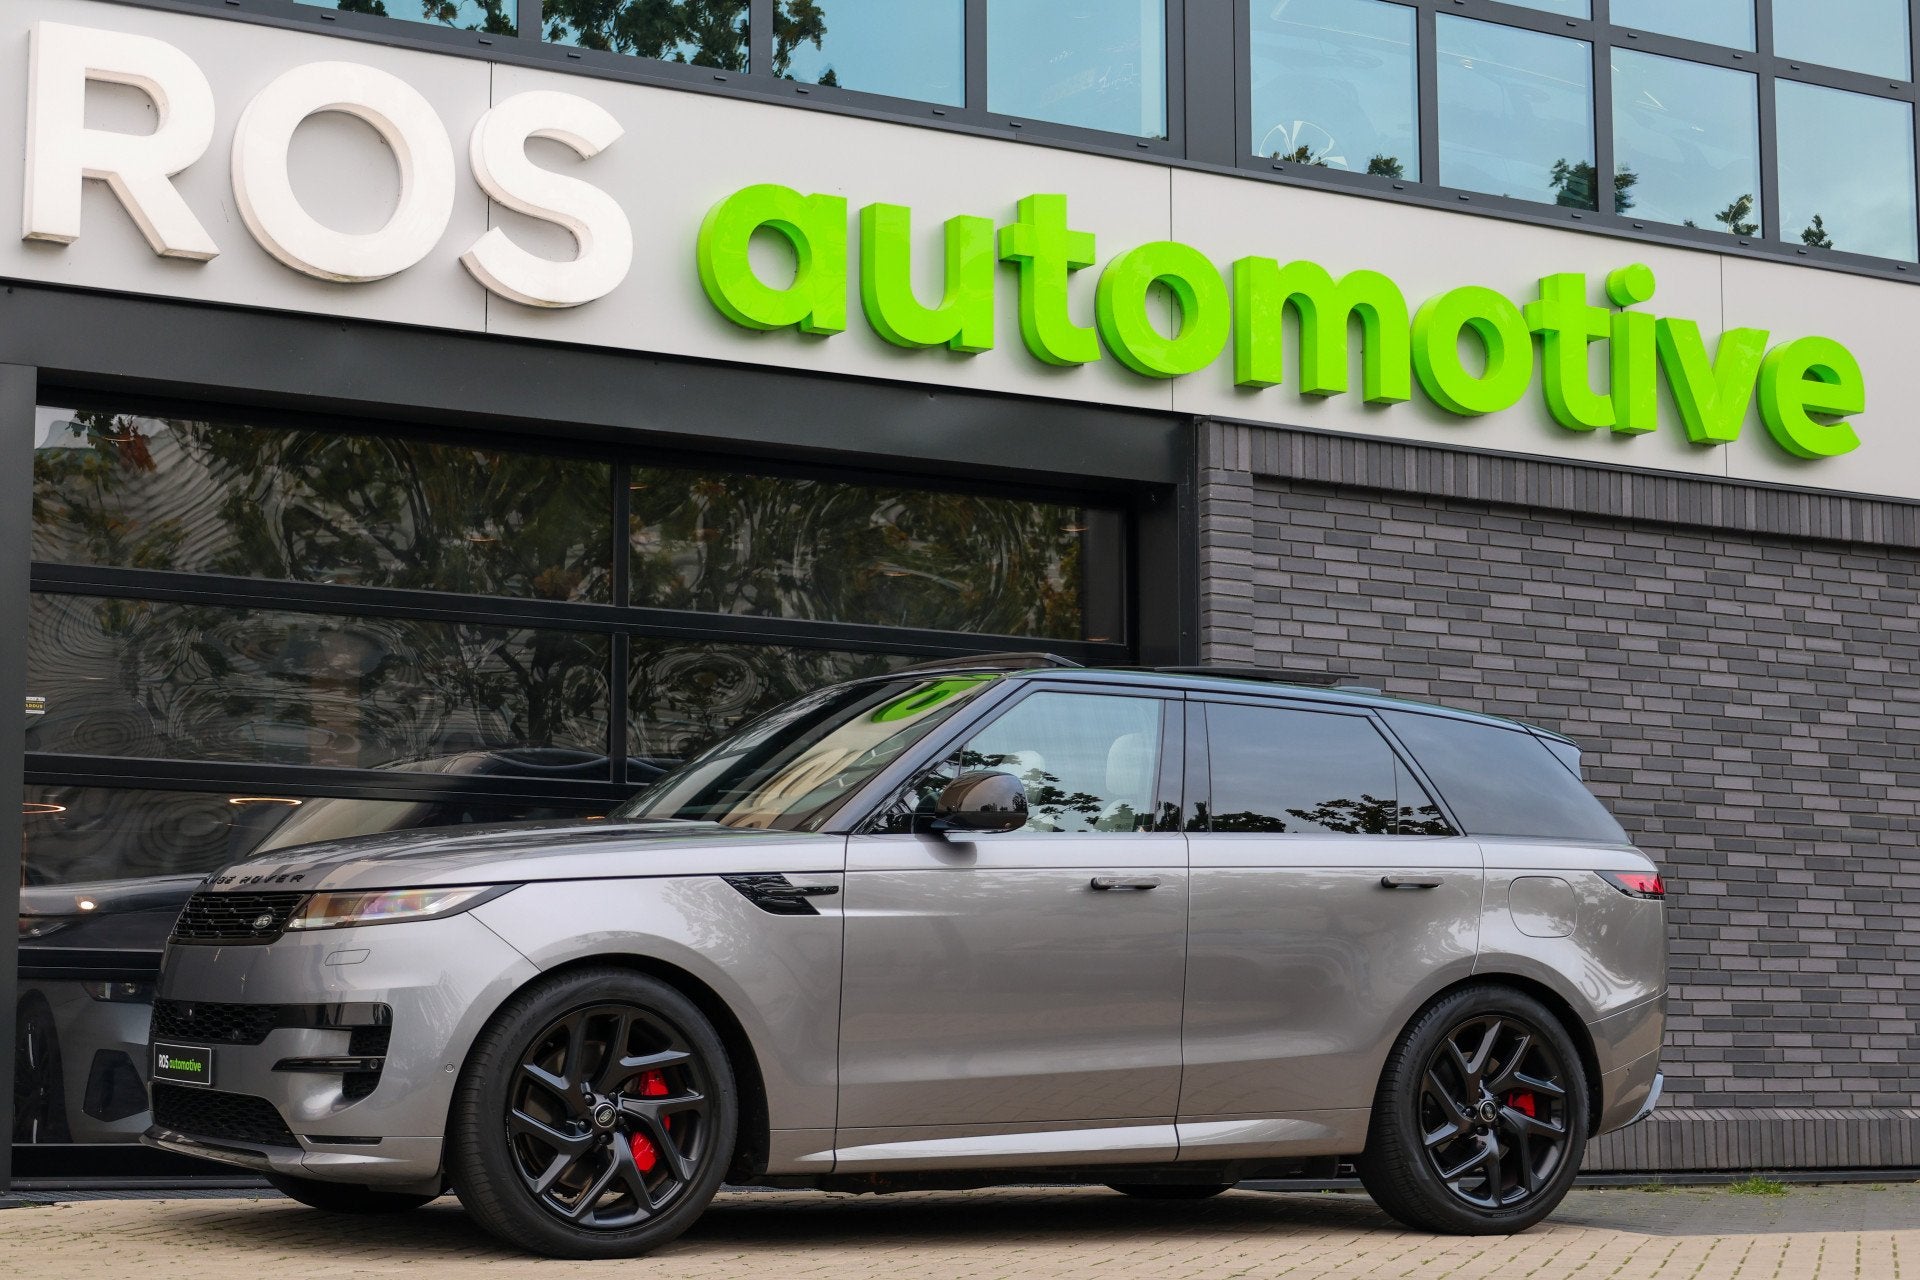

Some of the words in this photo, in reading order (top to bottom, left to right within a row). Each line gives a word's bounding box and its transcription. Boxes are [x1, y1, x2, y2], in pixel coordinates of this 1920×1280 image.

[22, 20, 633, 309] ROS
[697, 184, 1865, 459] automotive
[158, 1054, 169, 1069] ROS
[169, 1058, 202, 1072] automotive
